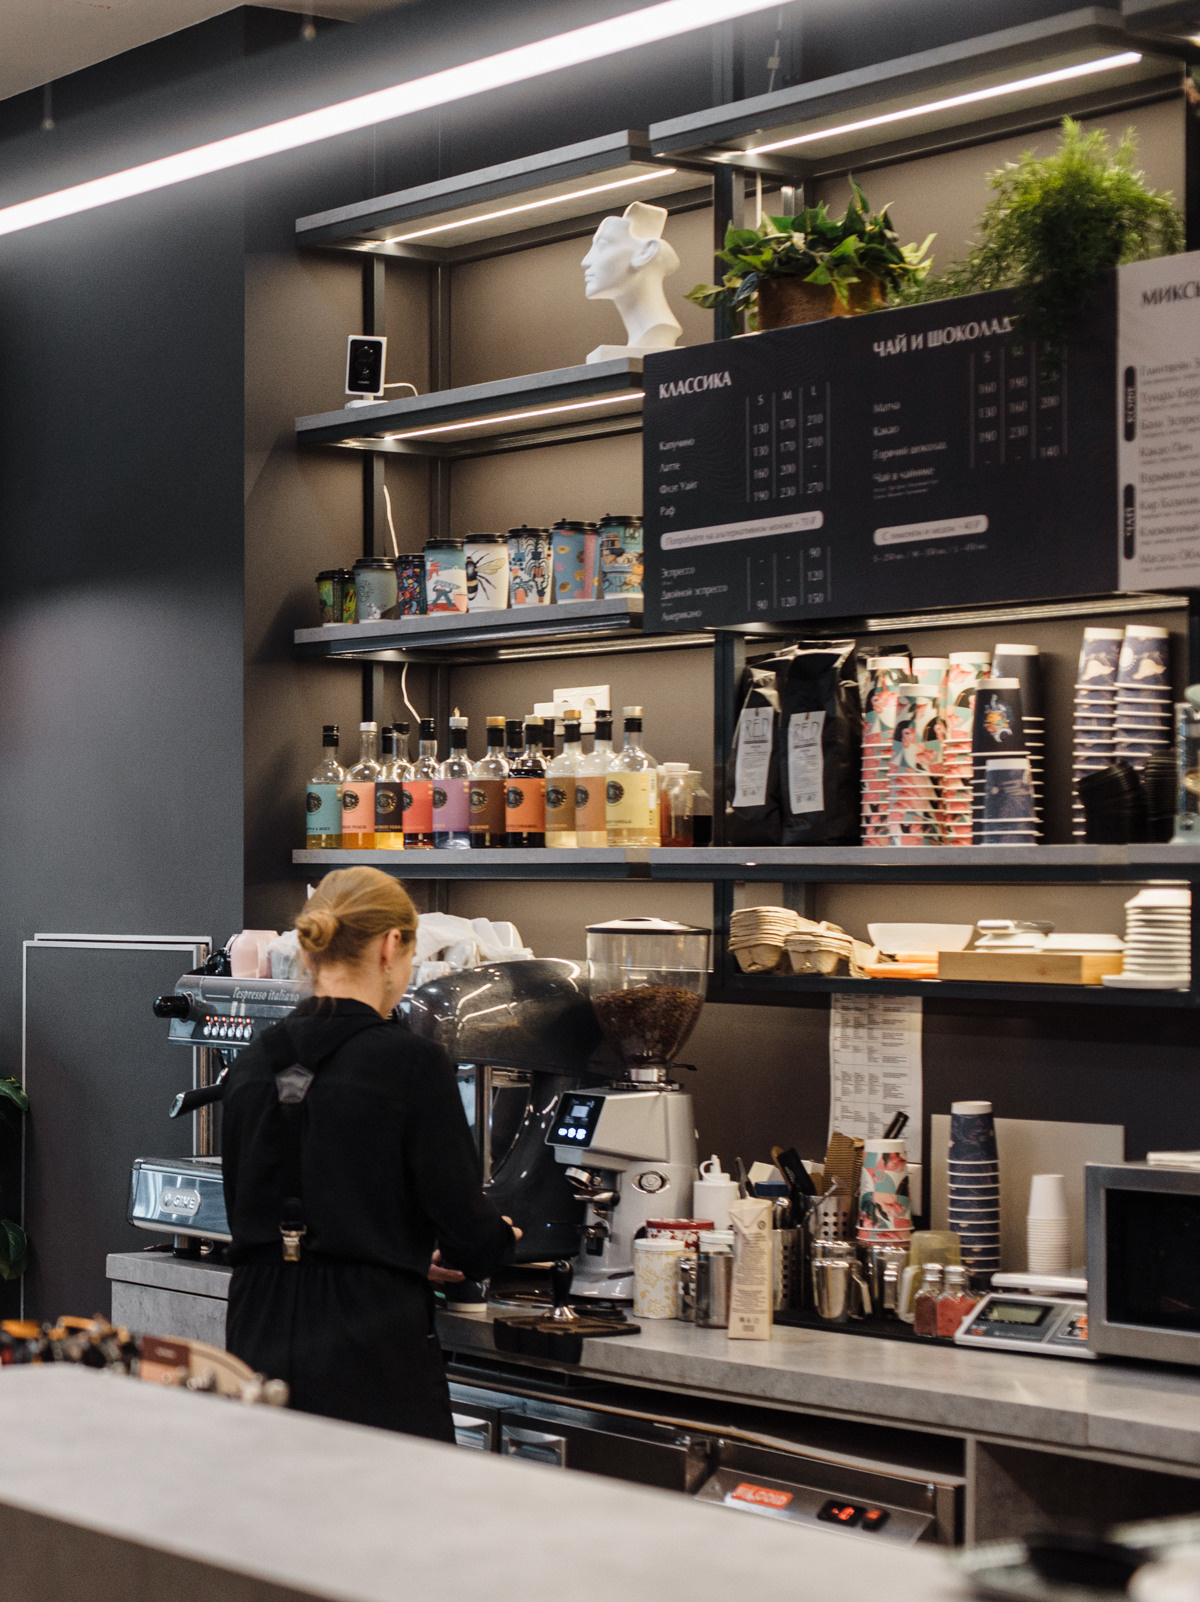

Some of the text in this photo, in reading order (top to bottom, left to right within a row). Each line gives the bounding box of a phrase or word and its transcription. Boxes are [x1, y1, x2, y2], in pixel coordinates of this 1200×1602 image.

[1141, 281, 1200, 306] МИКС
[873, 333, 907, 357] ЧАЙ
[910, 333, 924, 351] И
[658, 370, 732, 400] КЛАССИКА
[659, 505, 677, 518] Раф
